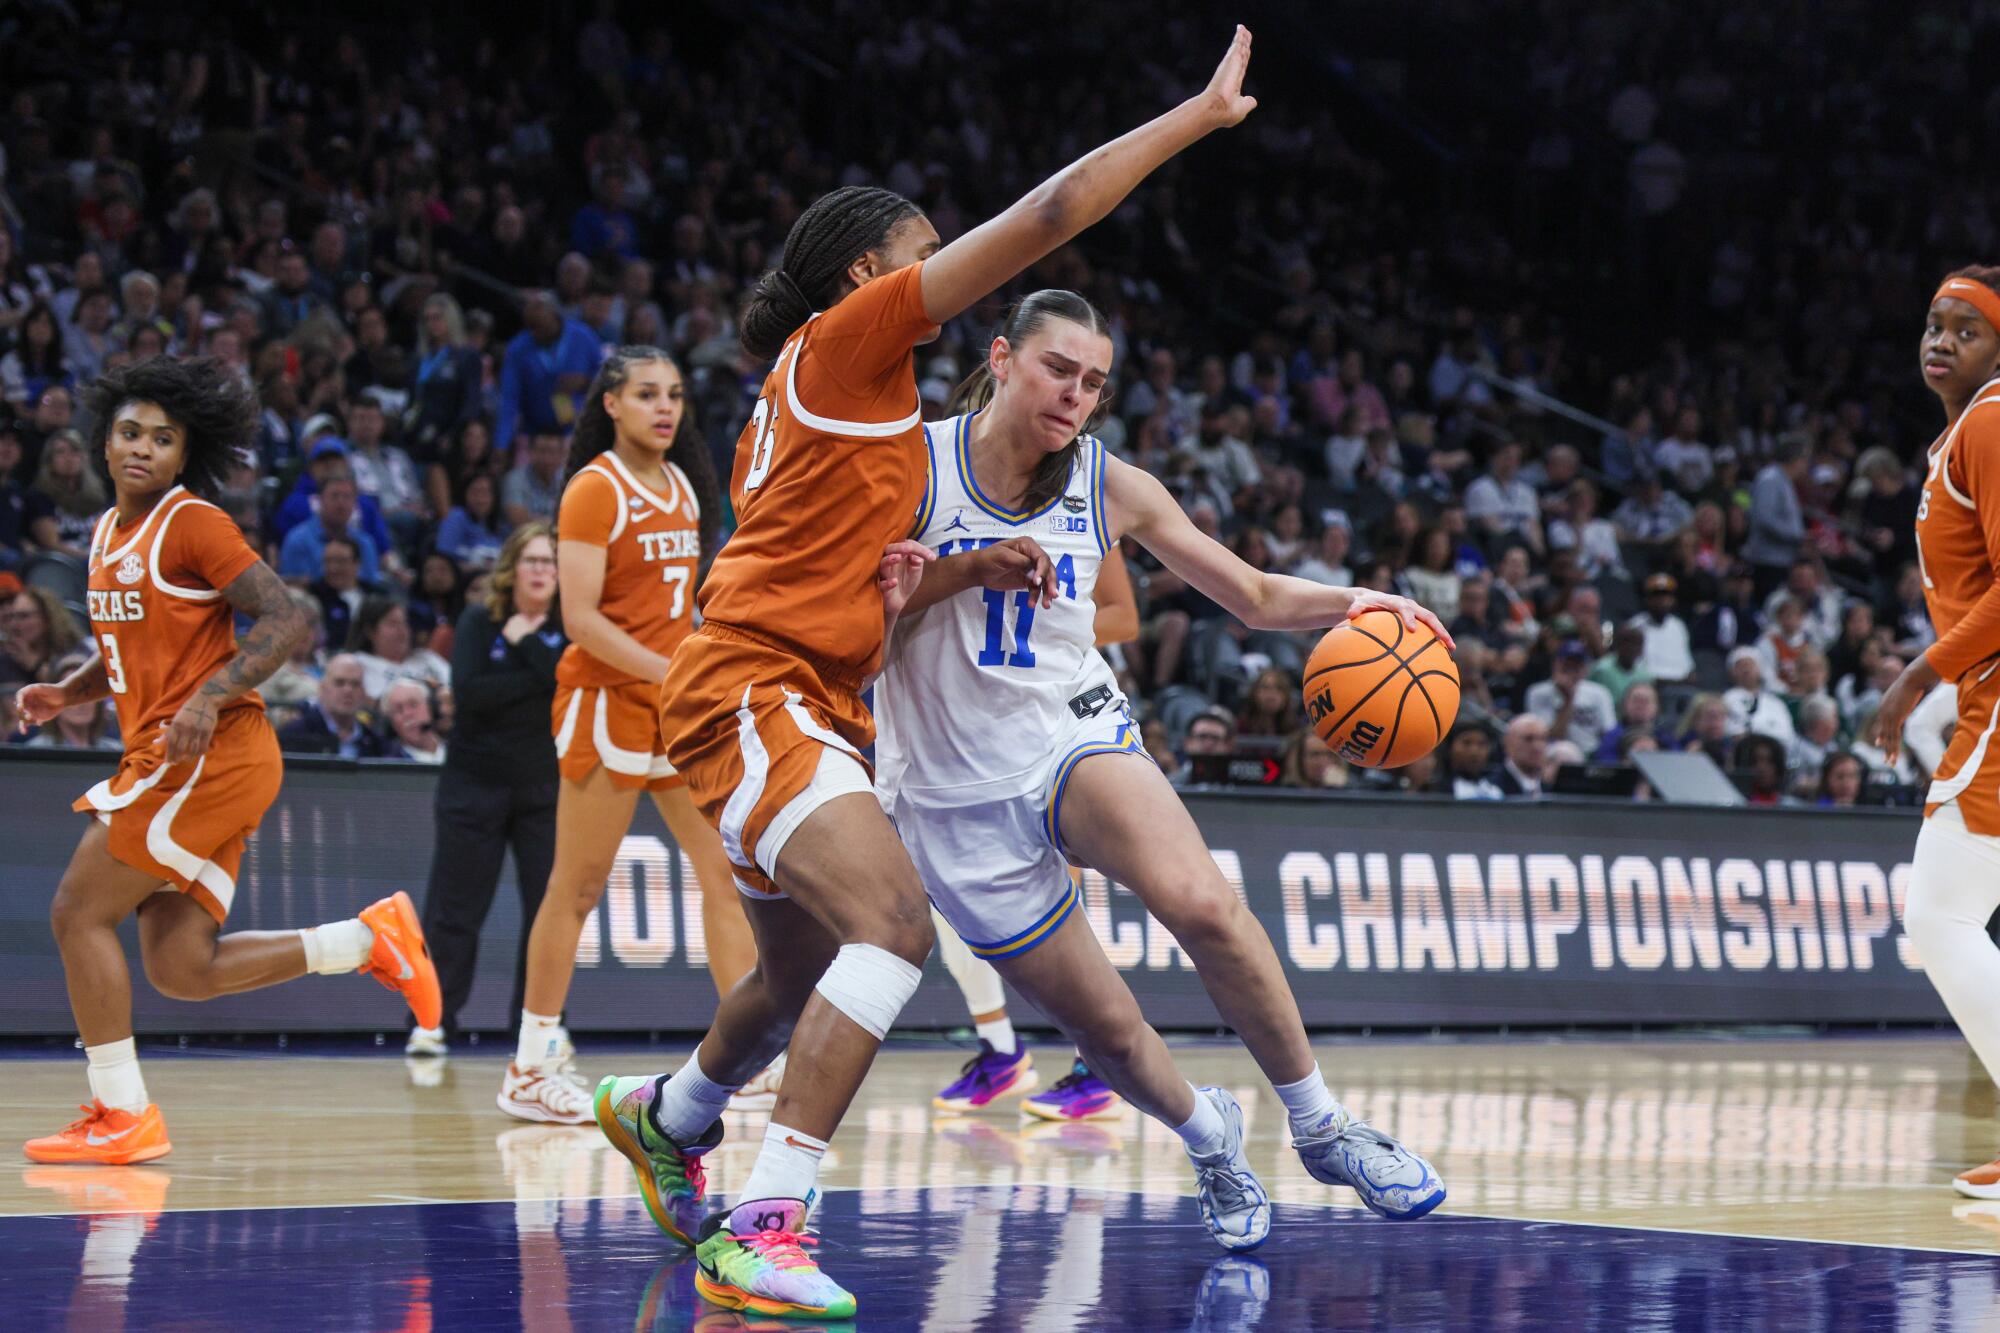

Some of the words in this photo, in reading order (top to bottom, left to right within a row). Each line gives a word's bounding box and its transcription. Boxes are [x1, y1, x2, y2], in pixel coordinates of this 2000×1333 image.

[663, 565, 690, 620] 7
[978, 585, 1036, 668] 11
[101, 633, 127, 694] 3
